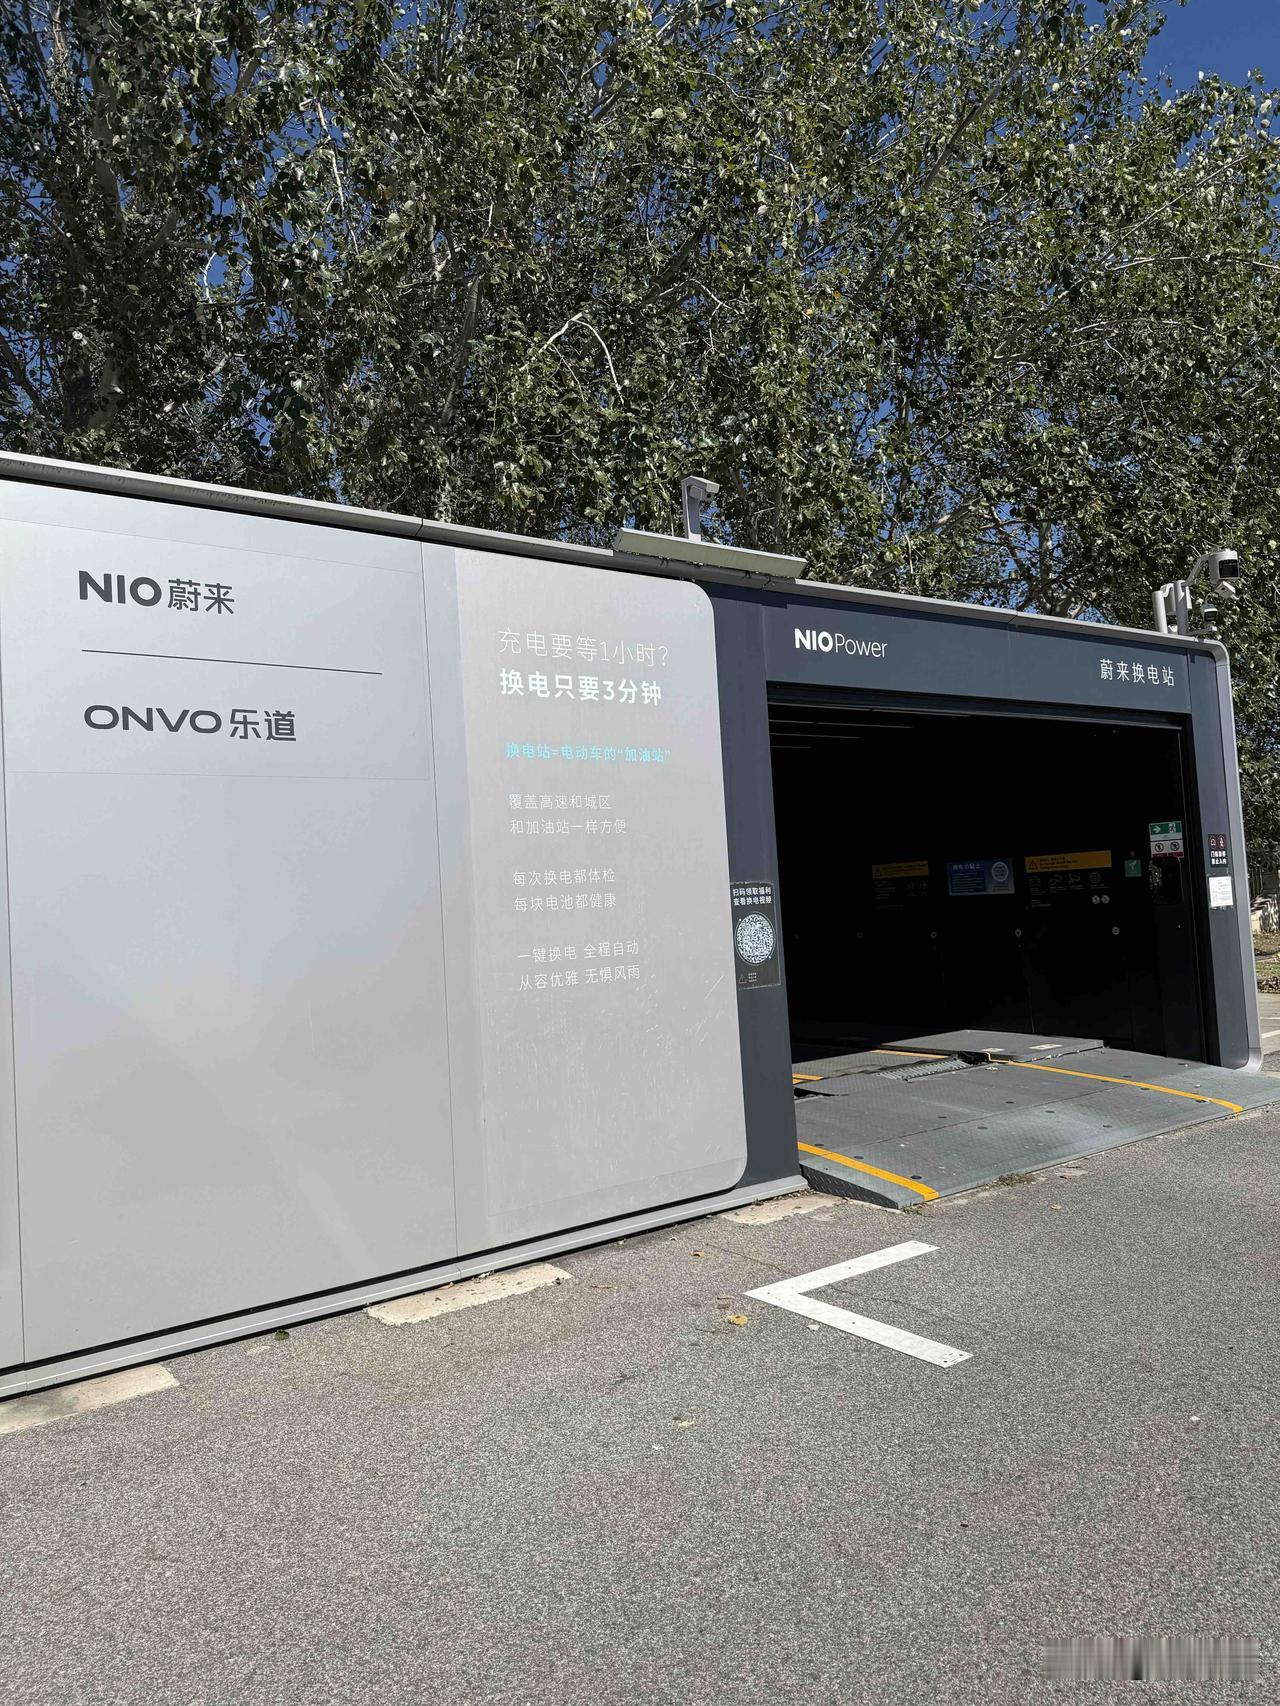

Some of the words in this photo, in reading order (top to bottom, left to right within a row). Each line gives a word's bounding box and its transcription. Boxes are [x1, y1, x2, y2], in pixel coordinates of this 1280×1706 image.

[78, 570, 235, 615] NIO蔚来
[1100, 658, 1175, 687] 蔚来换电站
[499, 667, 663, 706] 换电只要3分钟
[84, 704, 297, 742] ONVO乐道
[508, 793, 613, 810] 覆盖高速和城区
[510, 818, 627, 836] 和加油站一样方便
[512, 867, 616, 887] 每次换电都体检
[514, 891, 617, 912] 每块电池都健康
[732, 886, 772, 896] 扫码领取福利
[517, 943, 577, 963] 一键换电
[583, 938, 639, 959] 全程自动
[519, 969, 579, 991] 从容优雅
[584, 963, 640, 984] 无惧风雨
